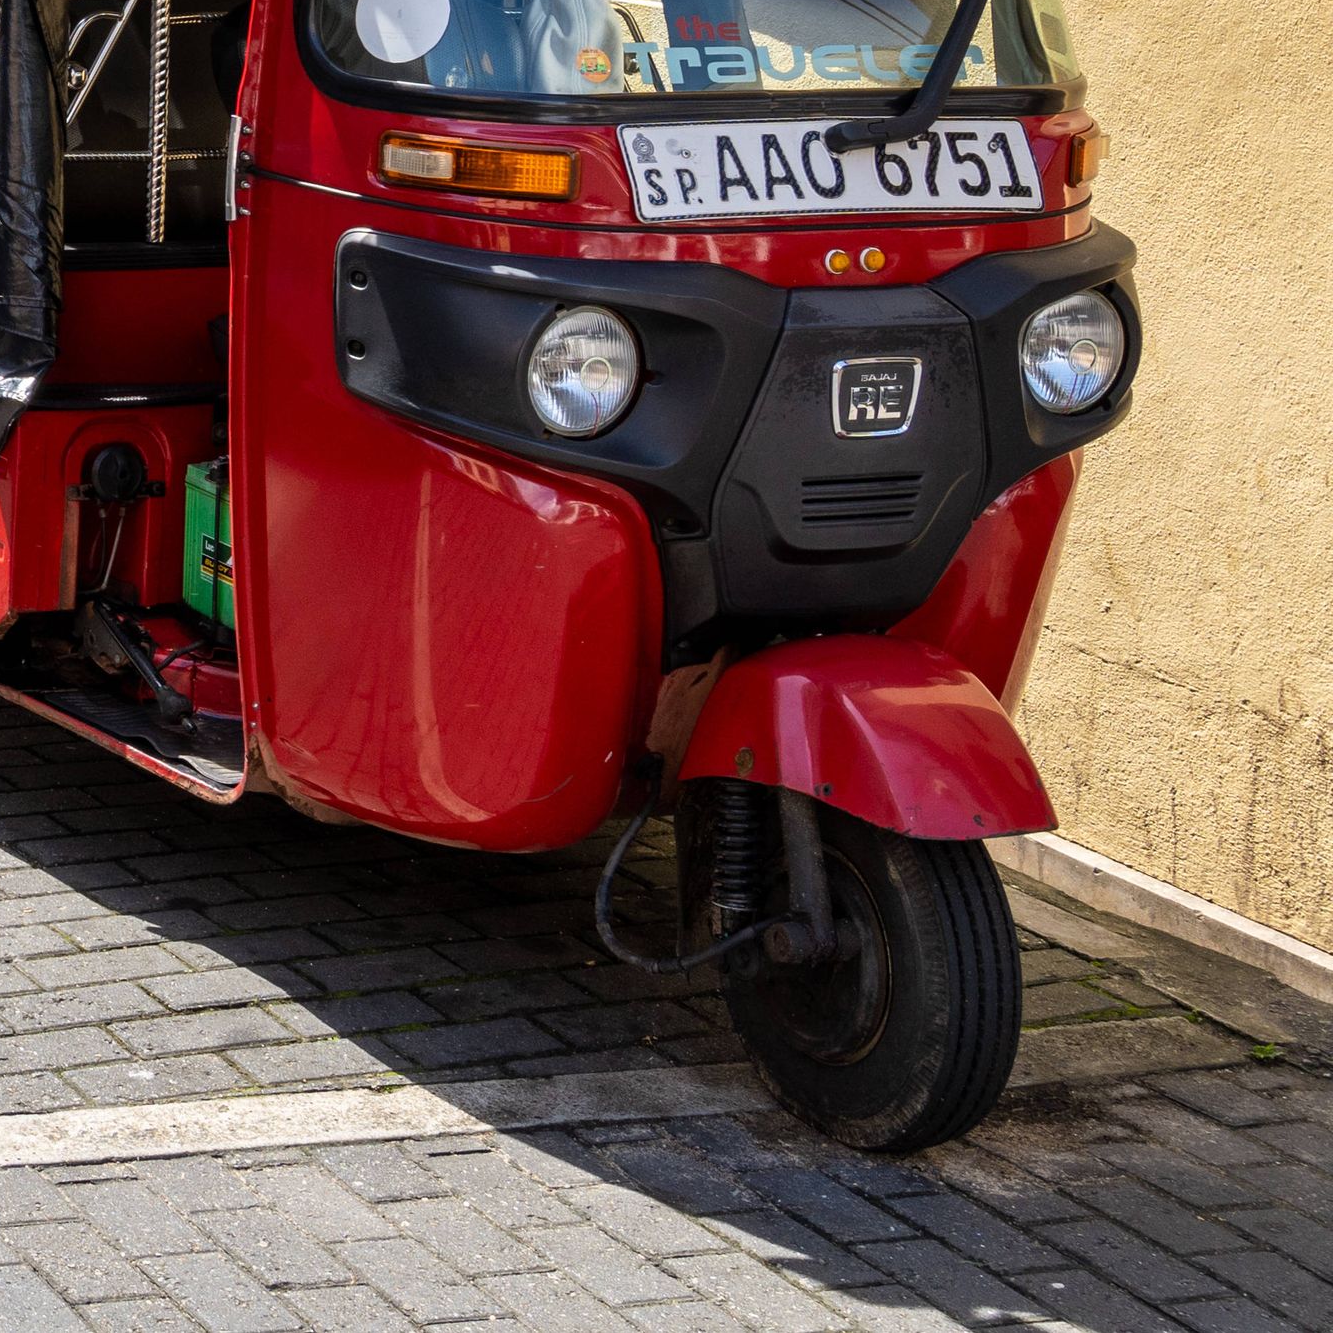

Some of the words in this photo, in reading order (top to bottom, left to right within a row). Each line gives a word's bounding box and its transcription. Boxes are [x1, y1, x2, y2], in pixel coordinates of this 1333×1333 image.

[675, 15, 741, 42] the
[716, 130, 846, 202] AAO
[874, 130, 1033, 198] 6751
[861, 372, 897, 382] BAJAJ
[848, 385, 903, 420] RE
